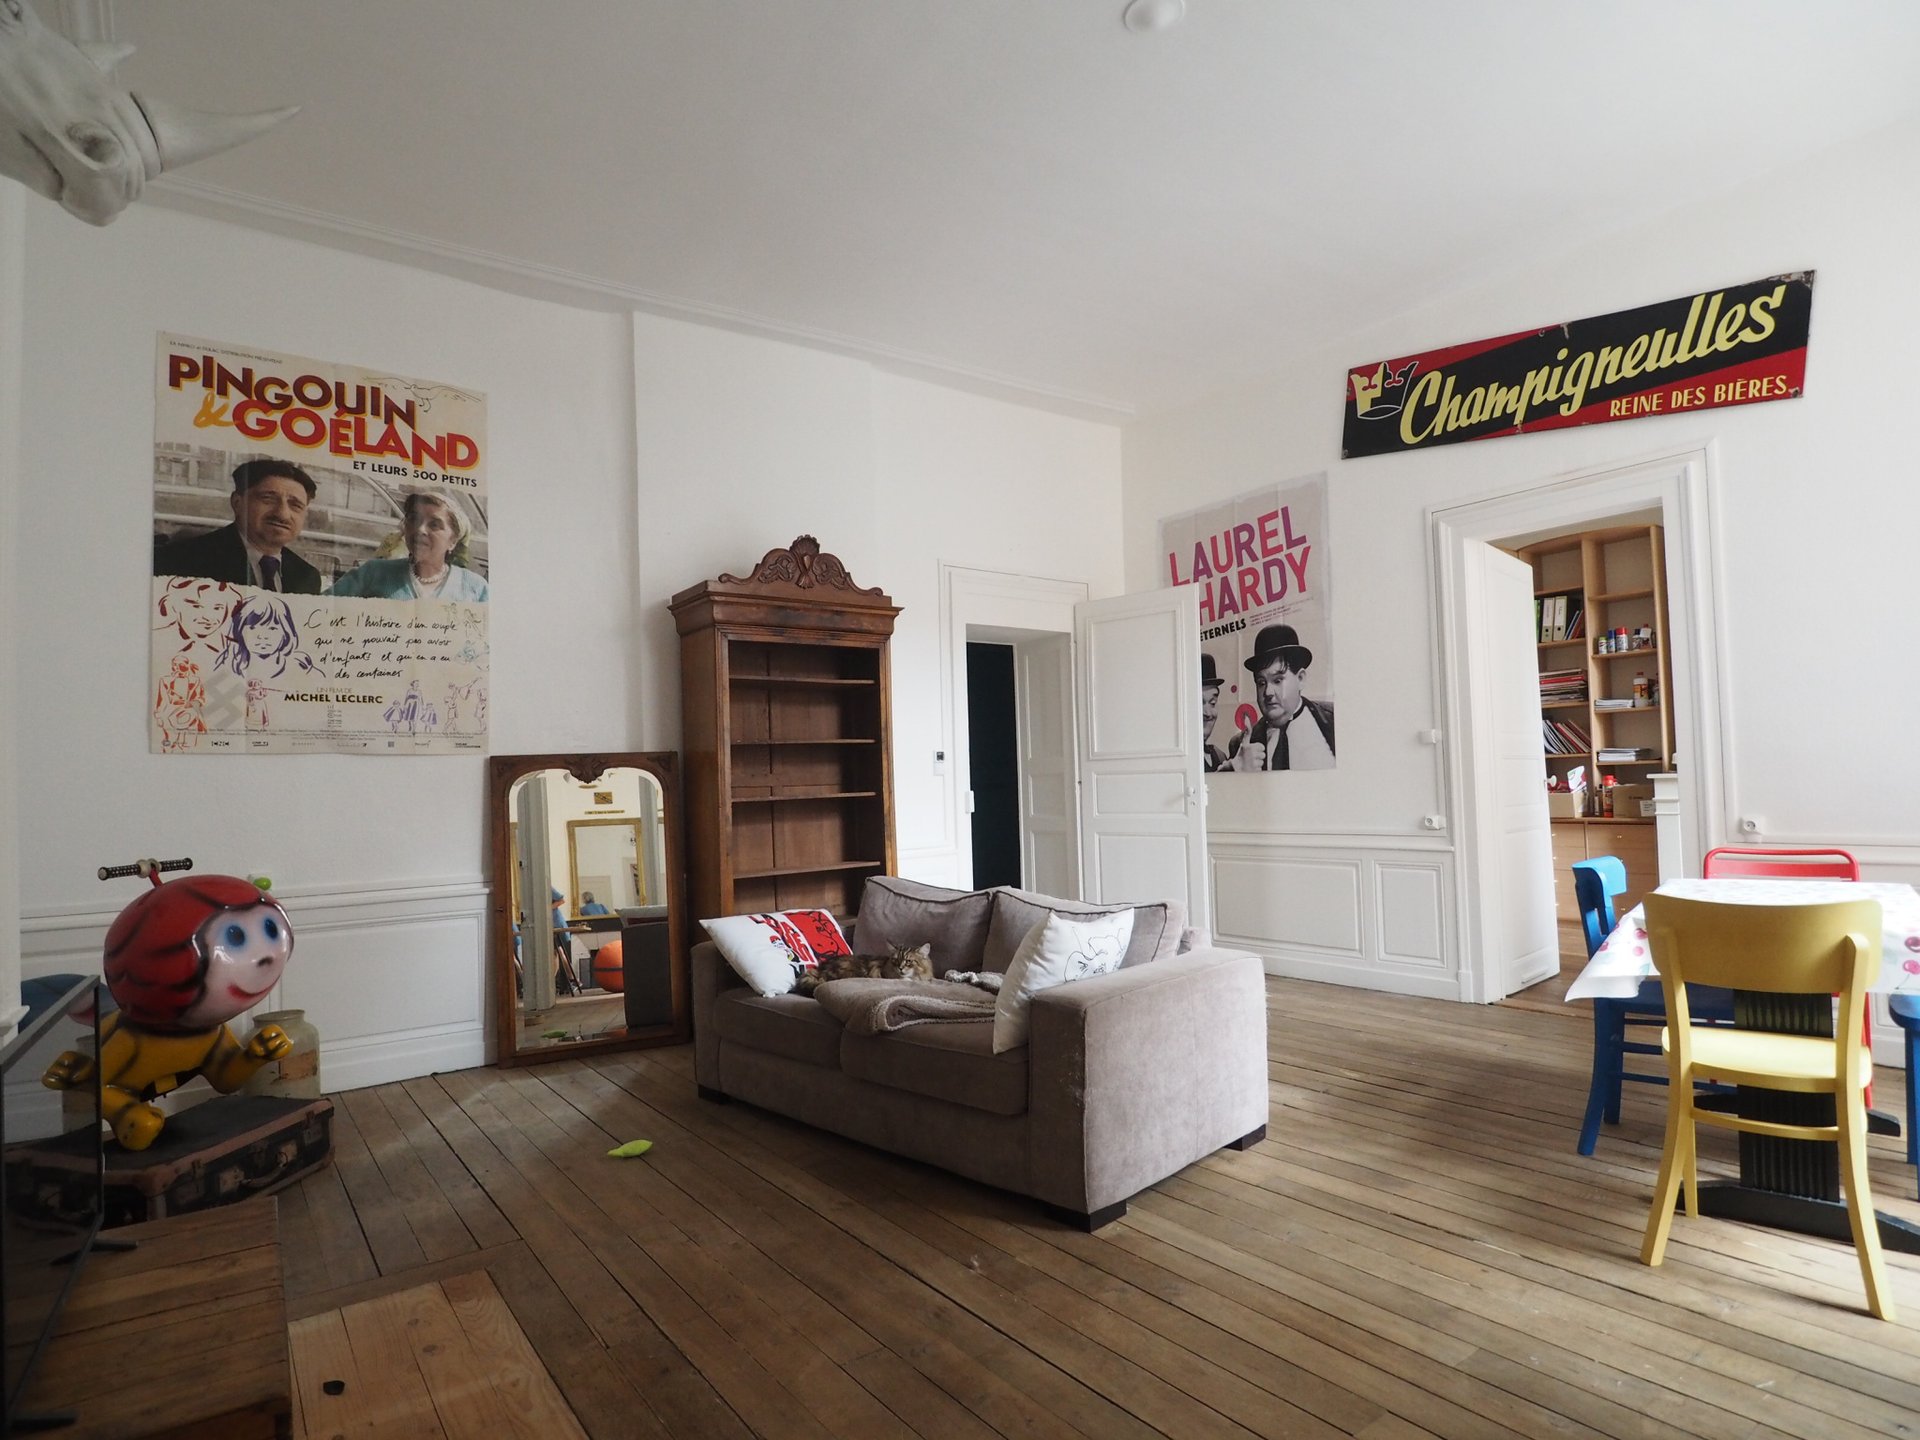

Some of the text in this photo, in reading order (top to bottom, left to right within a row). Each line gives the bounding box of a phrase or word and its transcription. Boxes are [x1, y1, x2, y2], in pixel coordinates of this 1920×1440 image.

[1400, 284, 1787, 444] Champigneulles
[168, 354, 416, 430] PINGOUIN
[1609, 374, 1788, 418] REINE DES BIÈRES
[193, 392, 481, 472] & GOÉLAND
[353, 461, 478, 488] ET LEURS 500 PETITS
[1169, 506, 1307, 587] LAUREL
[1200, 545, 1312, 626] HARDY
[356, 611, 402, 629] l'histoire
[407, 616, 428, 629] d'un
[432, 621, 458, 635] couple
[314, 637, 332, 648] qui
[340, 636, 354, 645] ne
[362, 635, 401, 648] pouvait
[405, 638, 422, 648] pas
[381, 651, 391, 662] et
[396, 655, 413, 666] qui
[334, 669, 350, 679] des
[284, 693, 384, 704] MICHEL LECLERC
